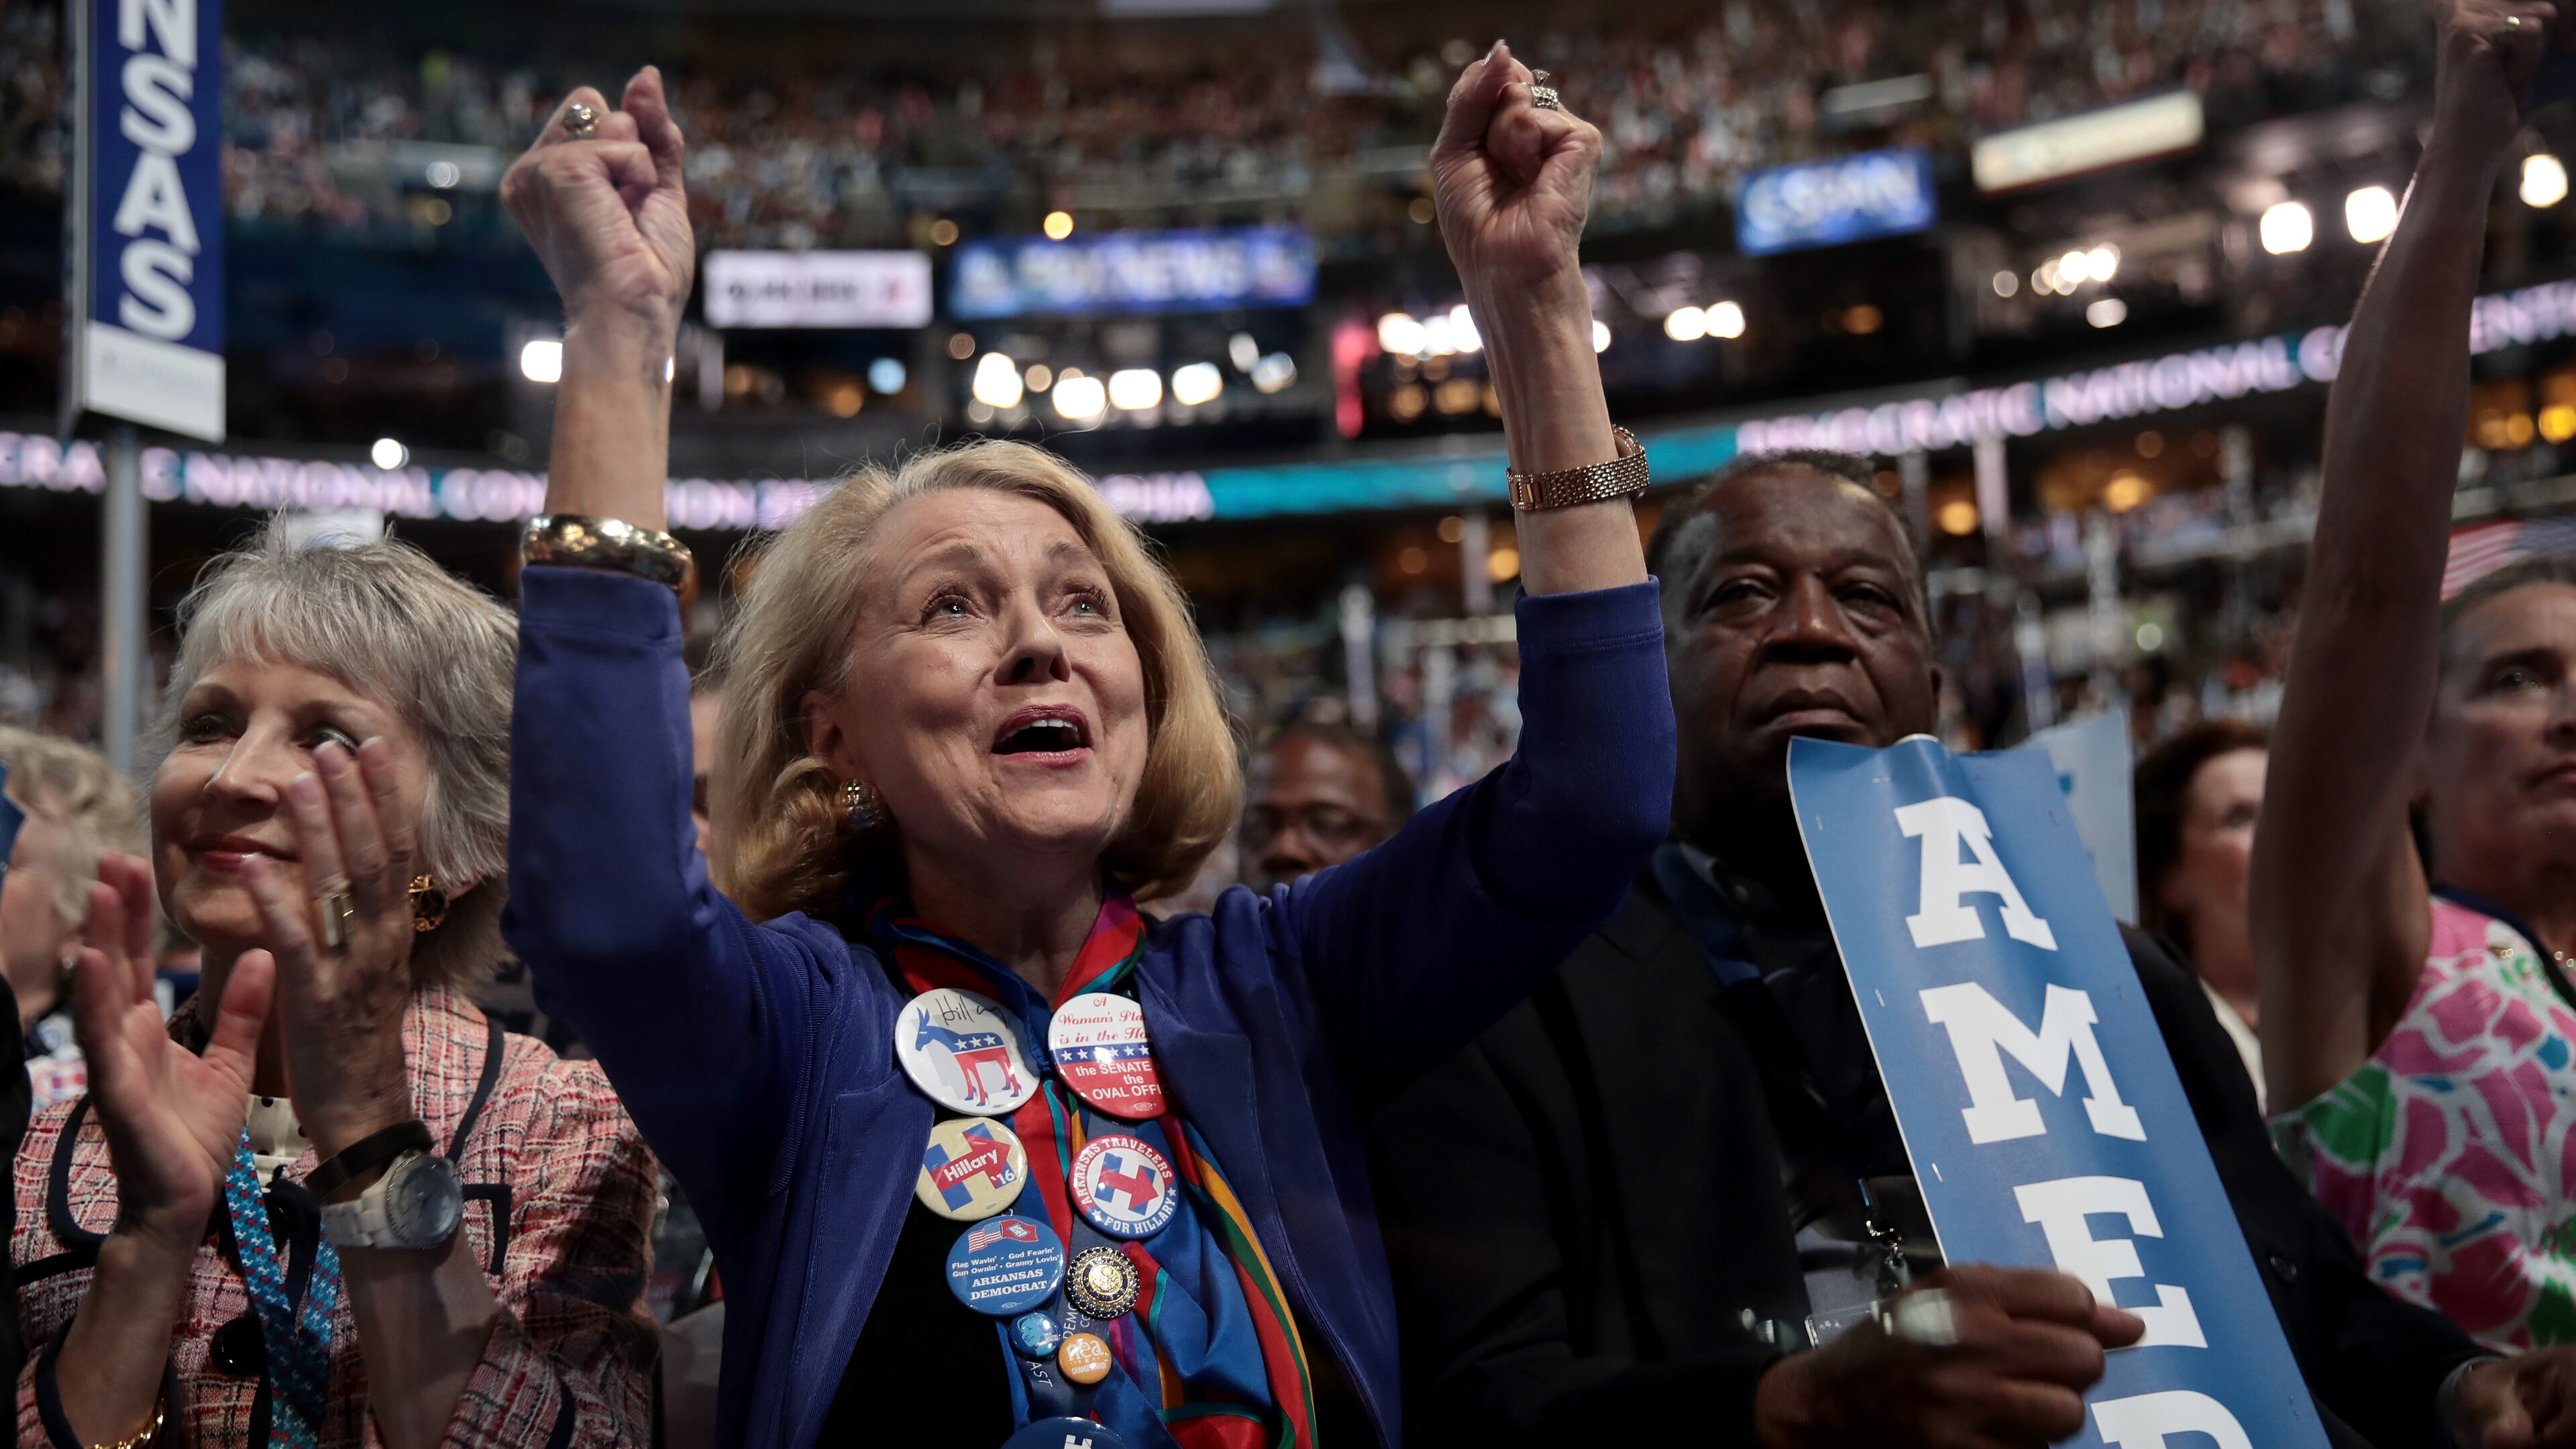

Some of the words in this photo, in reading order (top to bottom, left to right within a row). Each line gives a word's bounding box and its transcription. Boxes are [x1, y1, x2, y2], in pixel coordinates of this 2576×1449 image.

[1093, 996, 1107, 1007] A
[1059, 1012, 1113, 1025] Woman's
[1059, 1034, 1069, 1044] is
[1075, 1033, 1089, 1043] in
[1096, 1030, 1119, 1040] the
[1075, 1066, 1097, 1077] the
[1099, 1061, 1152, 1074] SENATE
[1123, 1074, 1144, 1085] the
[1092, 1087, 1130, 1100] OVAL
[943, 1149, 998, 1182] Hillary
[1073, 1143, 1101, 1205] ARKANSAS
[1102, 1137, 1173, 1179] TRAVELERS
[990, 1169, 1016, 1185] '16
[1104, 1216, 1130, 1233] FOR
[1134, 1197, 1176, 1234] HILLARY
[952, 1261, 969, 1270] Flag
[971, 1256, 998, 1266] Wavin'
[1027, 1247, 1055, 1256] Fearin'
[971, 1264, 998, 1274] Ownin'
[1006, 1258, 1034, 1268] Granny
[1036, 1254, 1060, 1264] Lovin'
[972, 1269, 1044, 1287] ARKANSAS
[970, 1281, 1047, 1300] DEMOCRAT
[1071, 1362, 1107, 1375] CHANGEAKER
